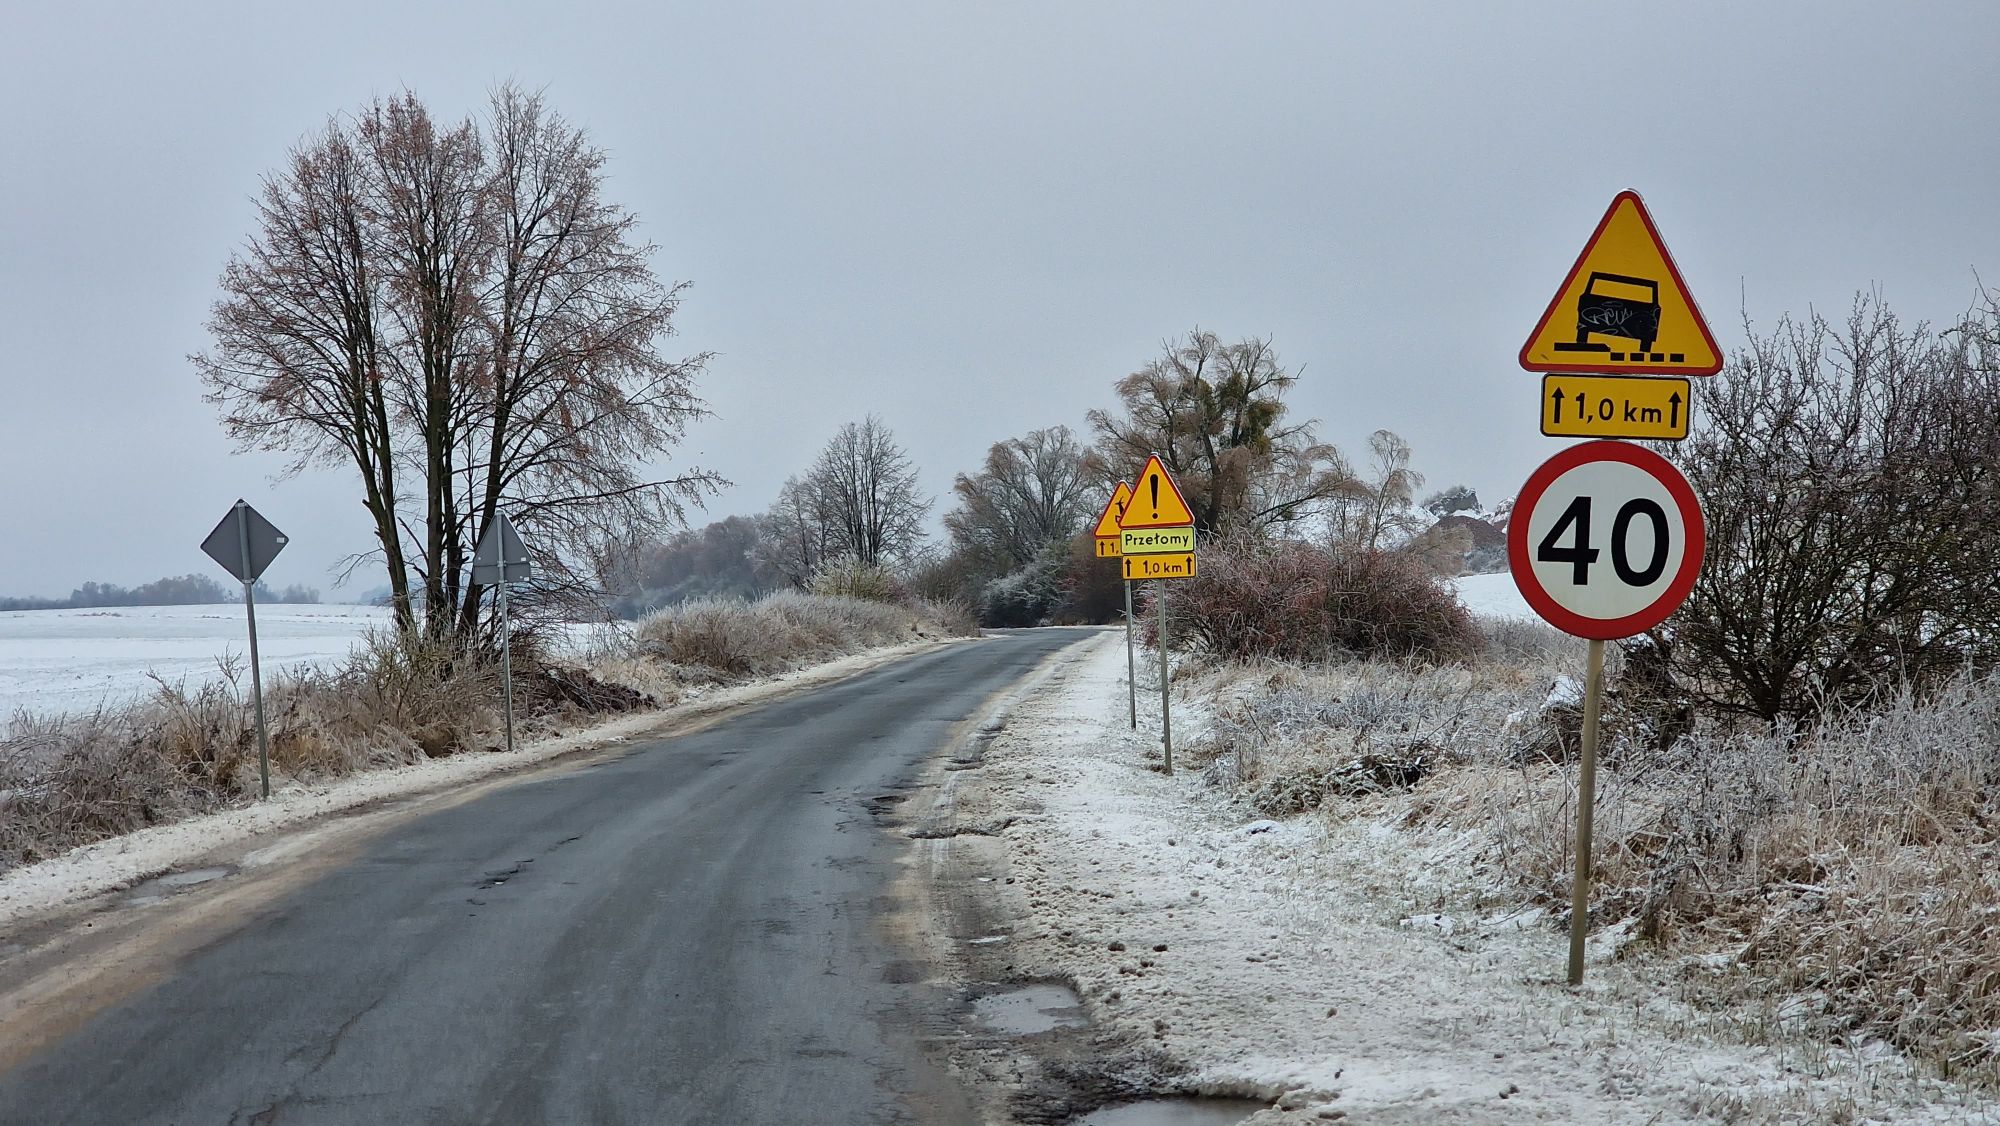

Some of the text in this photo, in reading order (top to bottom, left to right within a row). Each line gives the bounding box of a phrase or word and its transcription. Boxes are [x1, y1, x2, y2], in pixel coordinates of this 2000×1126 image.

[1575, 392, 1662, 424] 1,0 km
[1125, 533, 1189, 547] Przełomy
[1537, 496, 1670, 587] 40
[1110, 542, 1119, 554] 1,
[1143, 560, 1182, 575] 1,0 km
